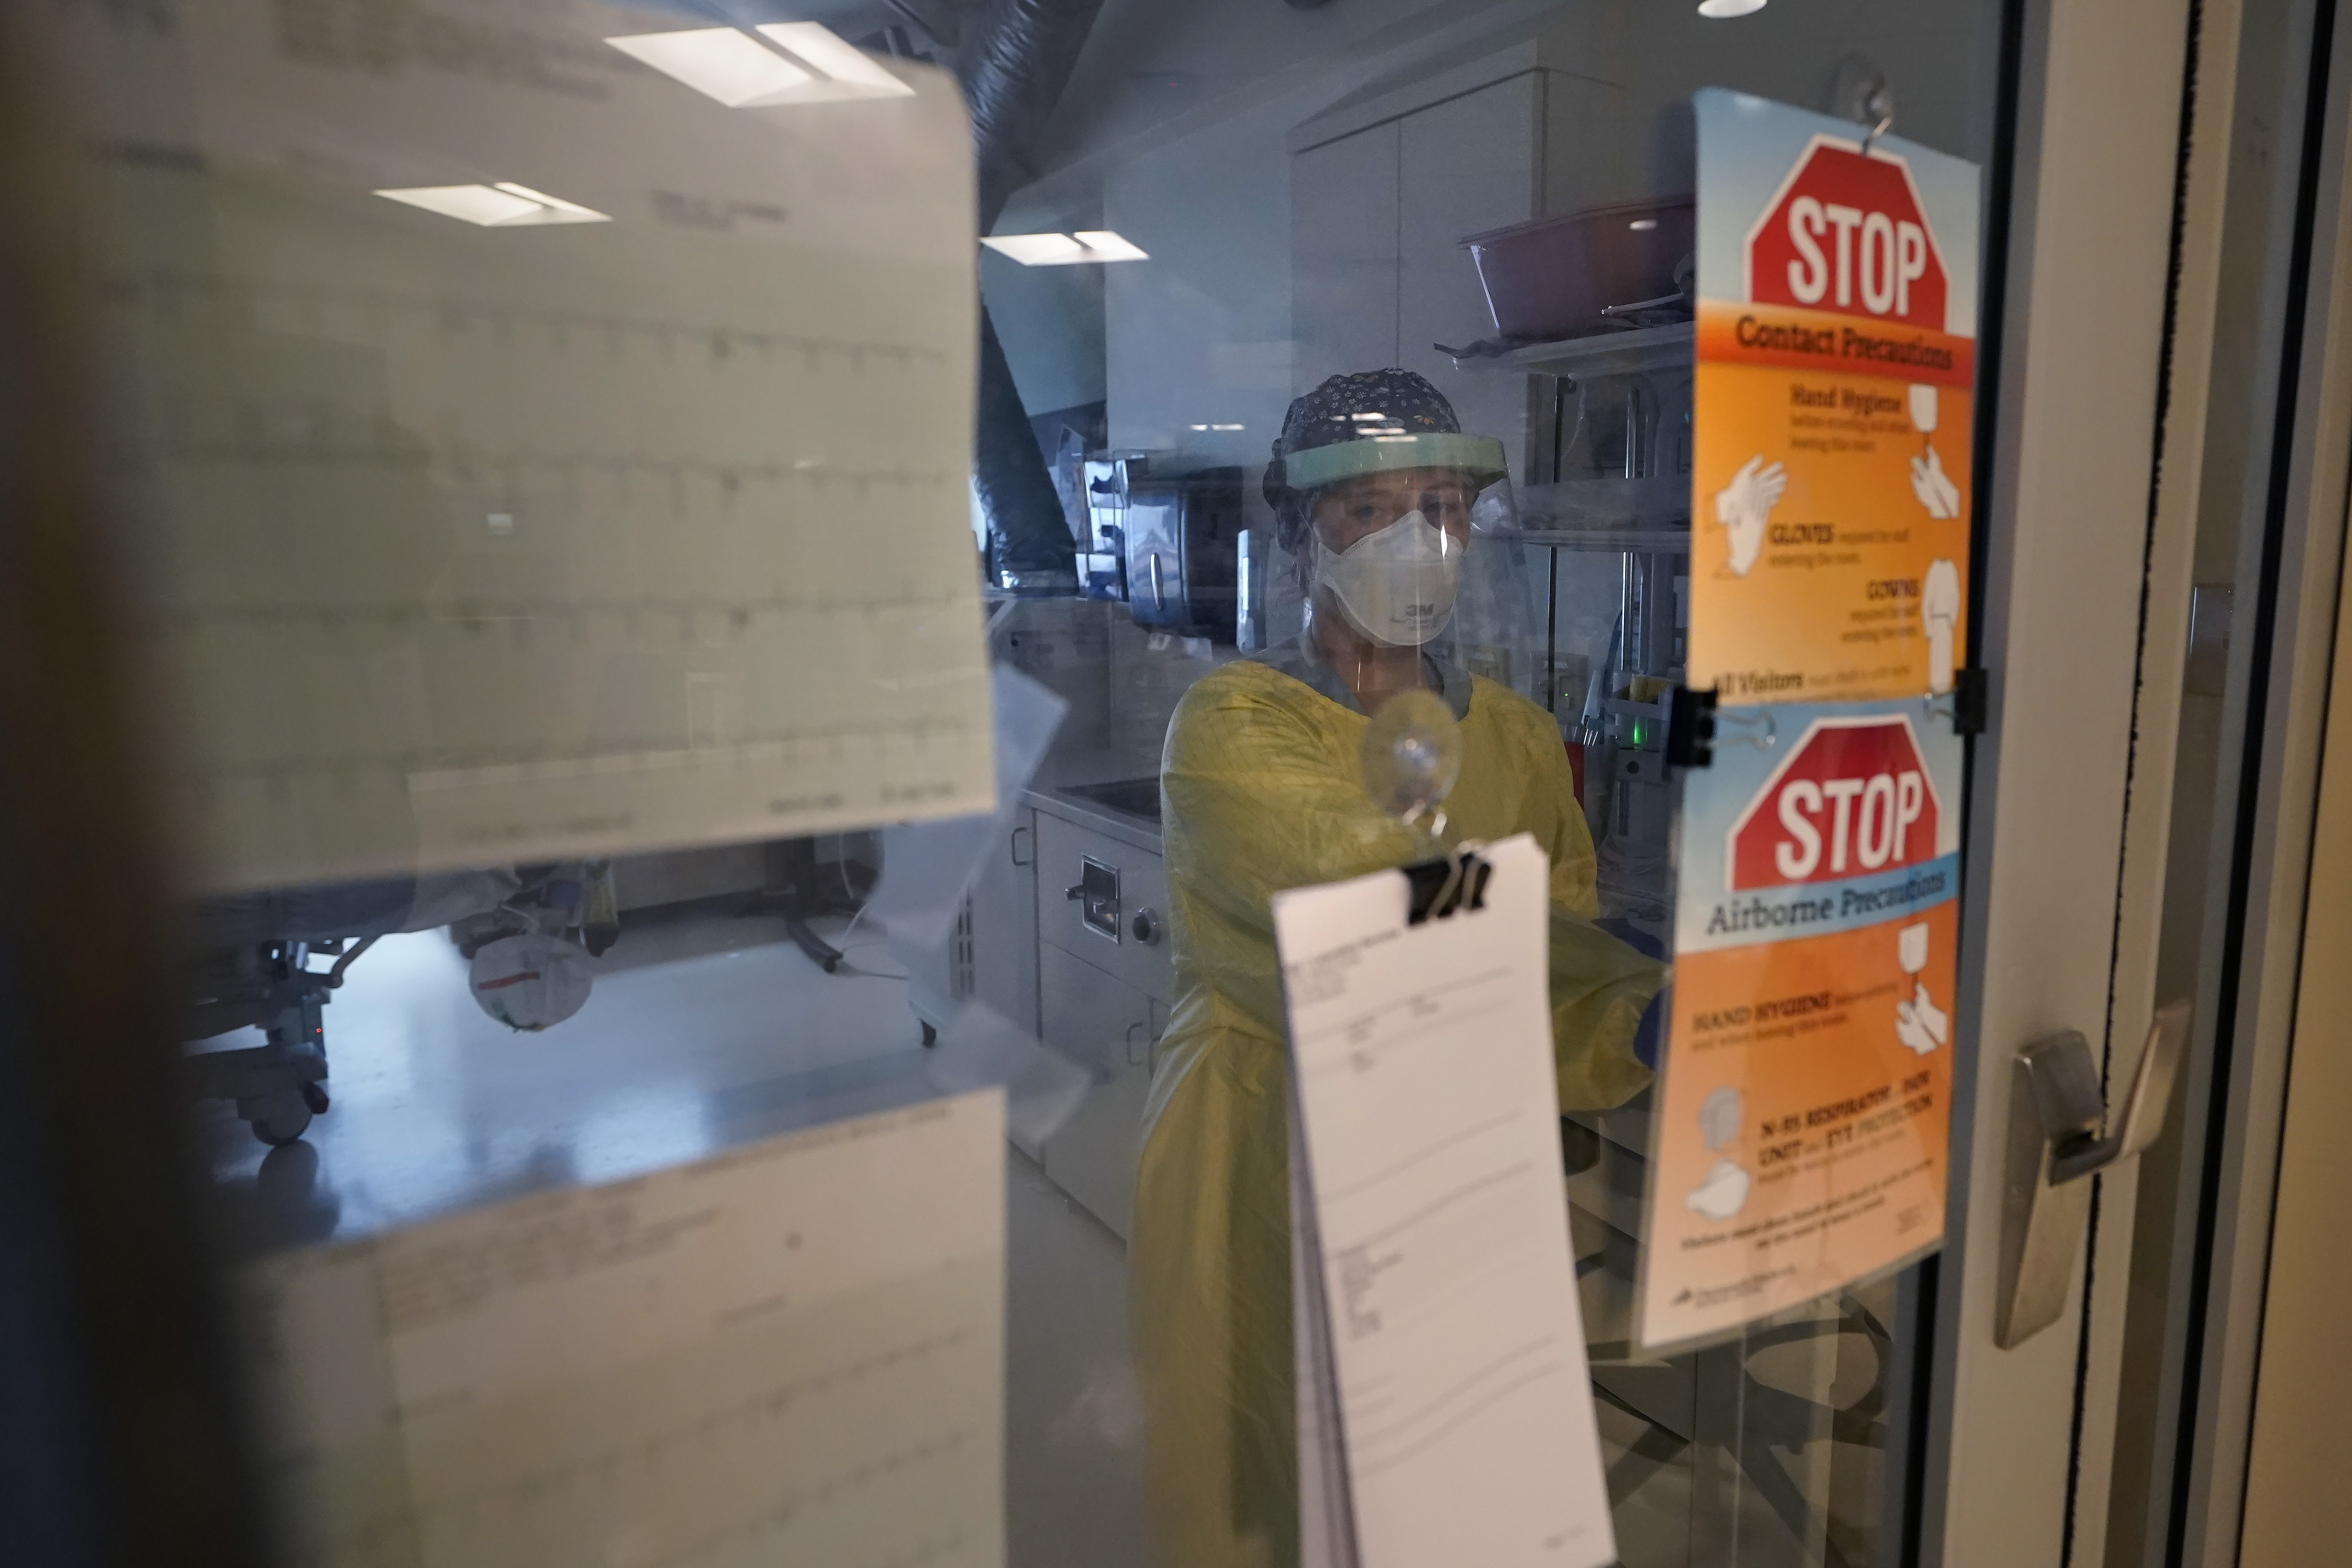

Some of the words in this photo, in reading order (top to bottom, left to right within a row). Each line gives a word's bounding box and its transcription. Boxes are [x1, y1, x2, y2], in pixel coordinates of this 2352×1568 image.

[1787, 195, 1927, 317] STOP
[1737, 315, 1835, 356] Contact
[1844, 327, 1954, 371] Precautions
[1790, 384, 1835, 410] Hand
[1841, 387, 1902, 418] Hygiene
[1769, 522, 1834, 545] GLOVES
[1405, 604, 1434, 618] 3M
[1866, 578, 1920, 601] GOWNS
[1738, 668, 1803, 692] Visitors
[1775, 770, 1924, 880] STOP
[1705, 890, 1834, 936] Airborne
[1841, 868, 1947, 919] Precautions
[1692, 1005, 1753, 1034] HAND
[1754, 991, 1831, 1022] HYGIENE
[1858, 1092, 1933, 1136] PROTECTION
